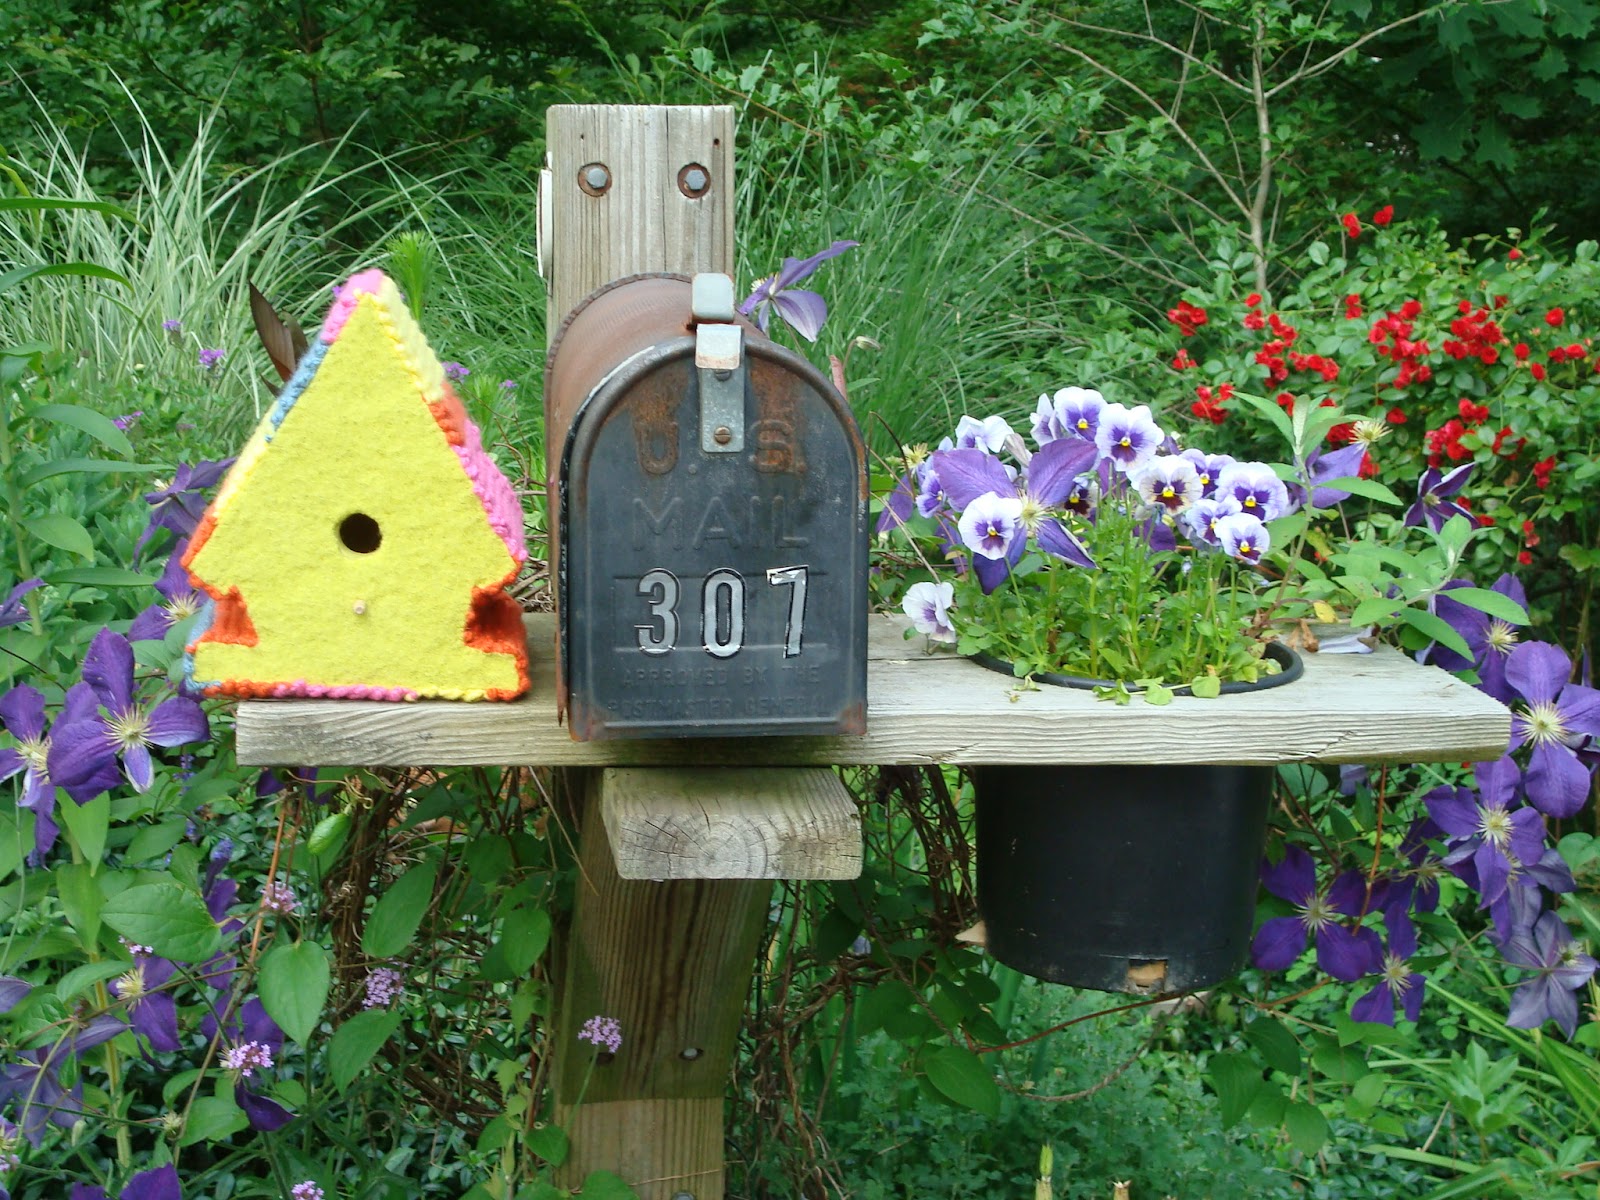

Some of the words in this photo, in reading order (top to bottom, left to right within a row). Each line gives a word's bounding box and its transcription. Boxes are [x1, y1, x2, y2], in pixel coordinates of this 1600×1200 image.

[632, 494, 811, 551] MAIL
[634, 564, 810, 660] 307
[743, 665, 770, 687] BY
